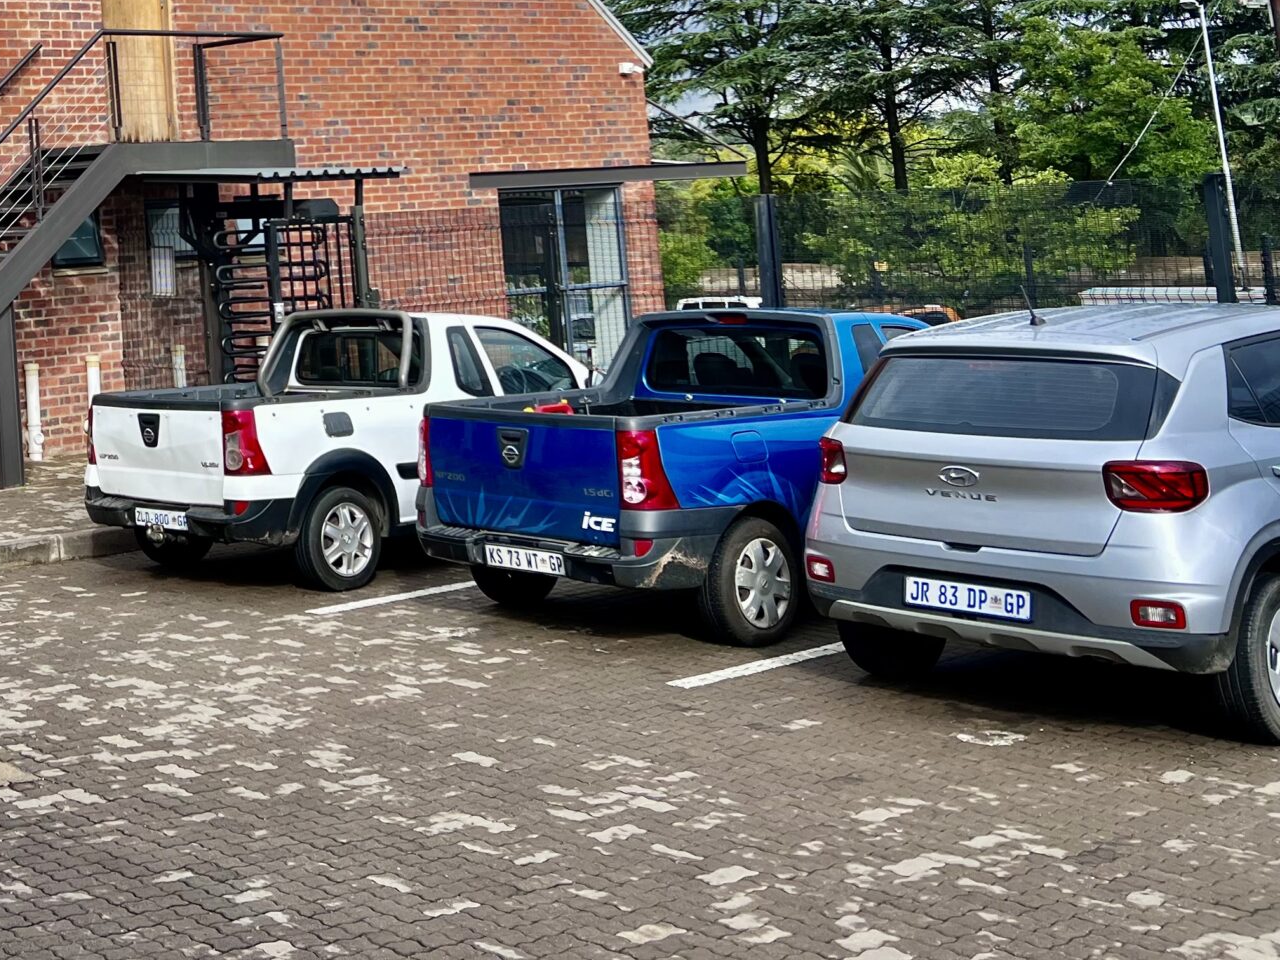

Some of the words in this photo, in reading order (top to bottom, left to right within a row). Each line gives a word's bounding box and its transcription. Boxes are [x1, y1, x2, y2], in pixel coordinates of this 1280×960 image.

[925, 488, 998, 502] VENUE
[488, 547, 504, 564] KS
[507, 550, 522, 568] 73
[526, 555, 539, 571] WT
[549, 557, 562, 574] GP
[910, 581, 929, 602] JR
[938, 584, 958, 607] 83
[967, 588, 988, 610] DP
[1004, 592, 1025, 615] GP
